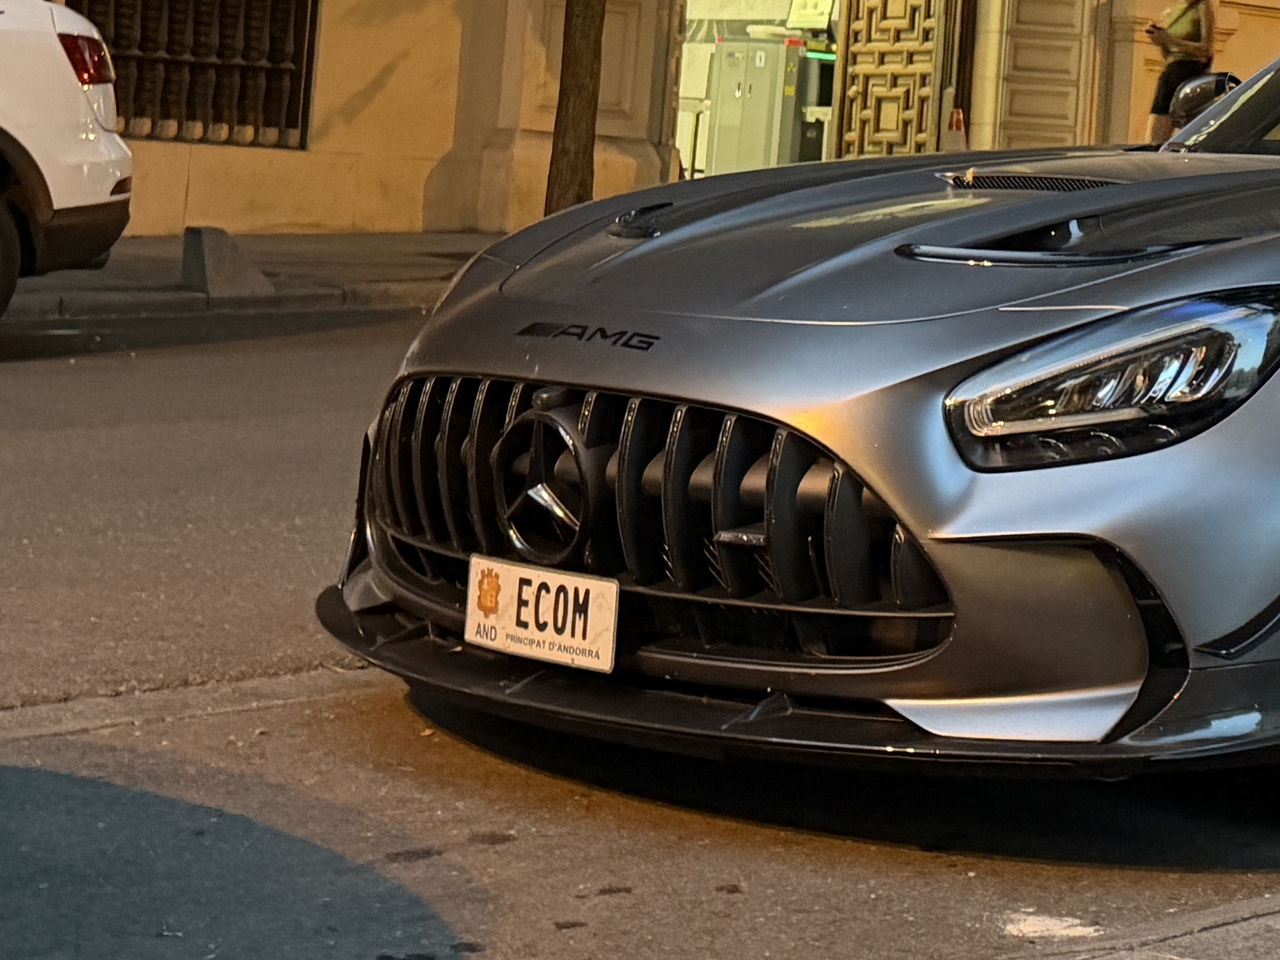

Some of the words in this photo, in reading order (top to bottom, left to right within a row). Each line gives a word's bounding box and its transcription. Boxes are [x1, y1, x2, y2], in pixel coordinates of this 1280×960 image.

[552, 324, 661, 352] AMG
[516, 577, 591, 641] ECOM
[475, 622, 498, 642] AND
[505, 632, 546, 650] PRINCIPAT
[548, 641, 601, 660] D'ANDORRA
